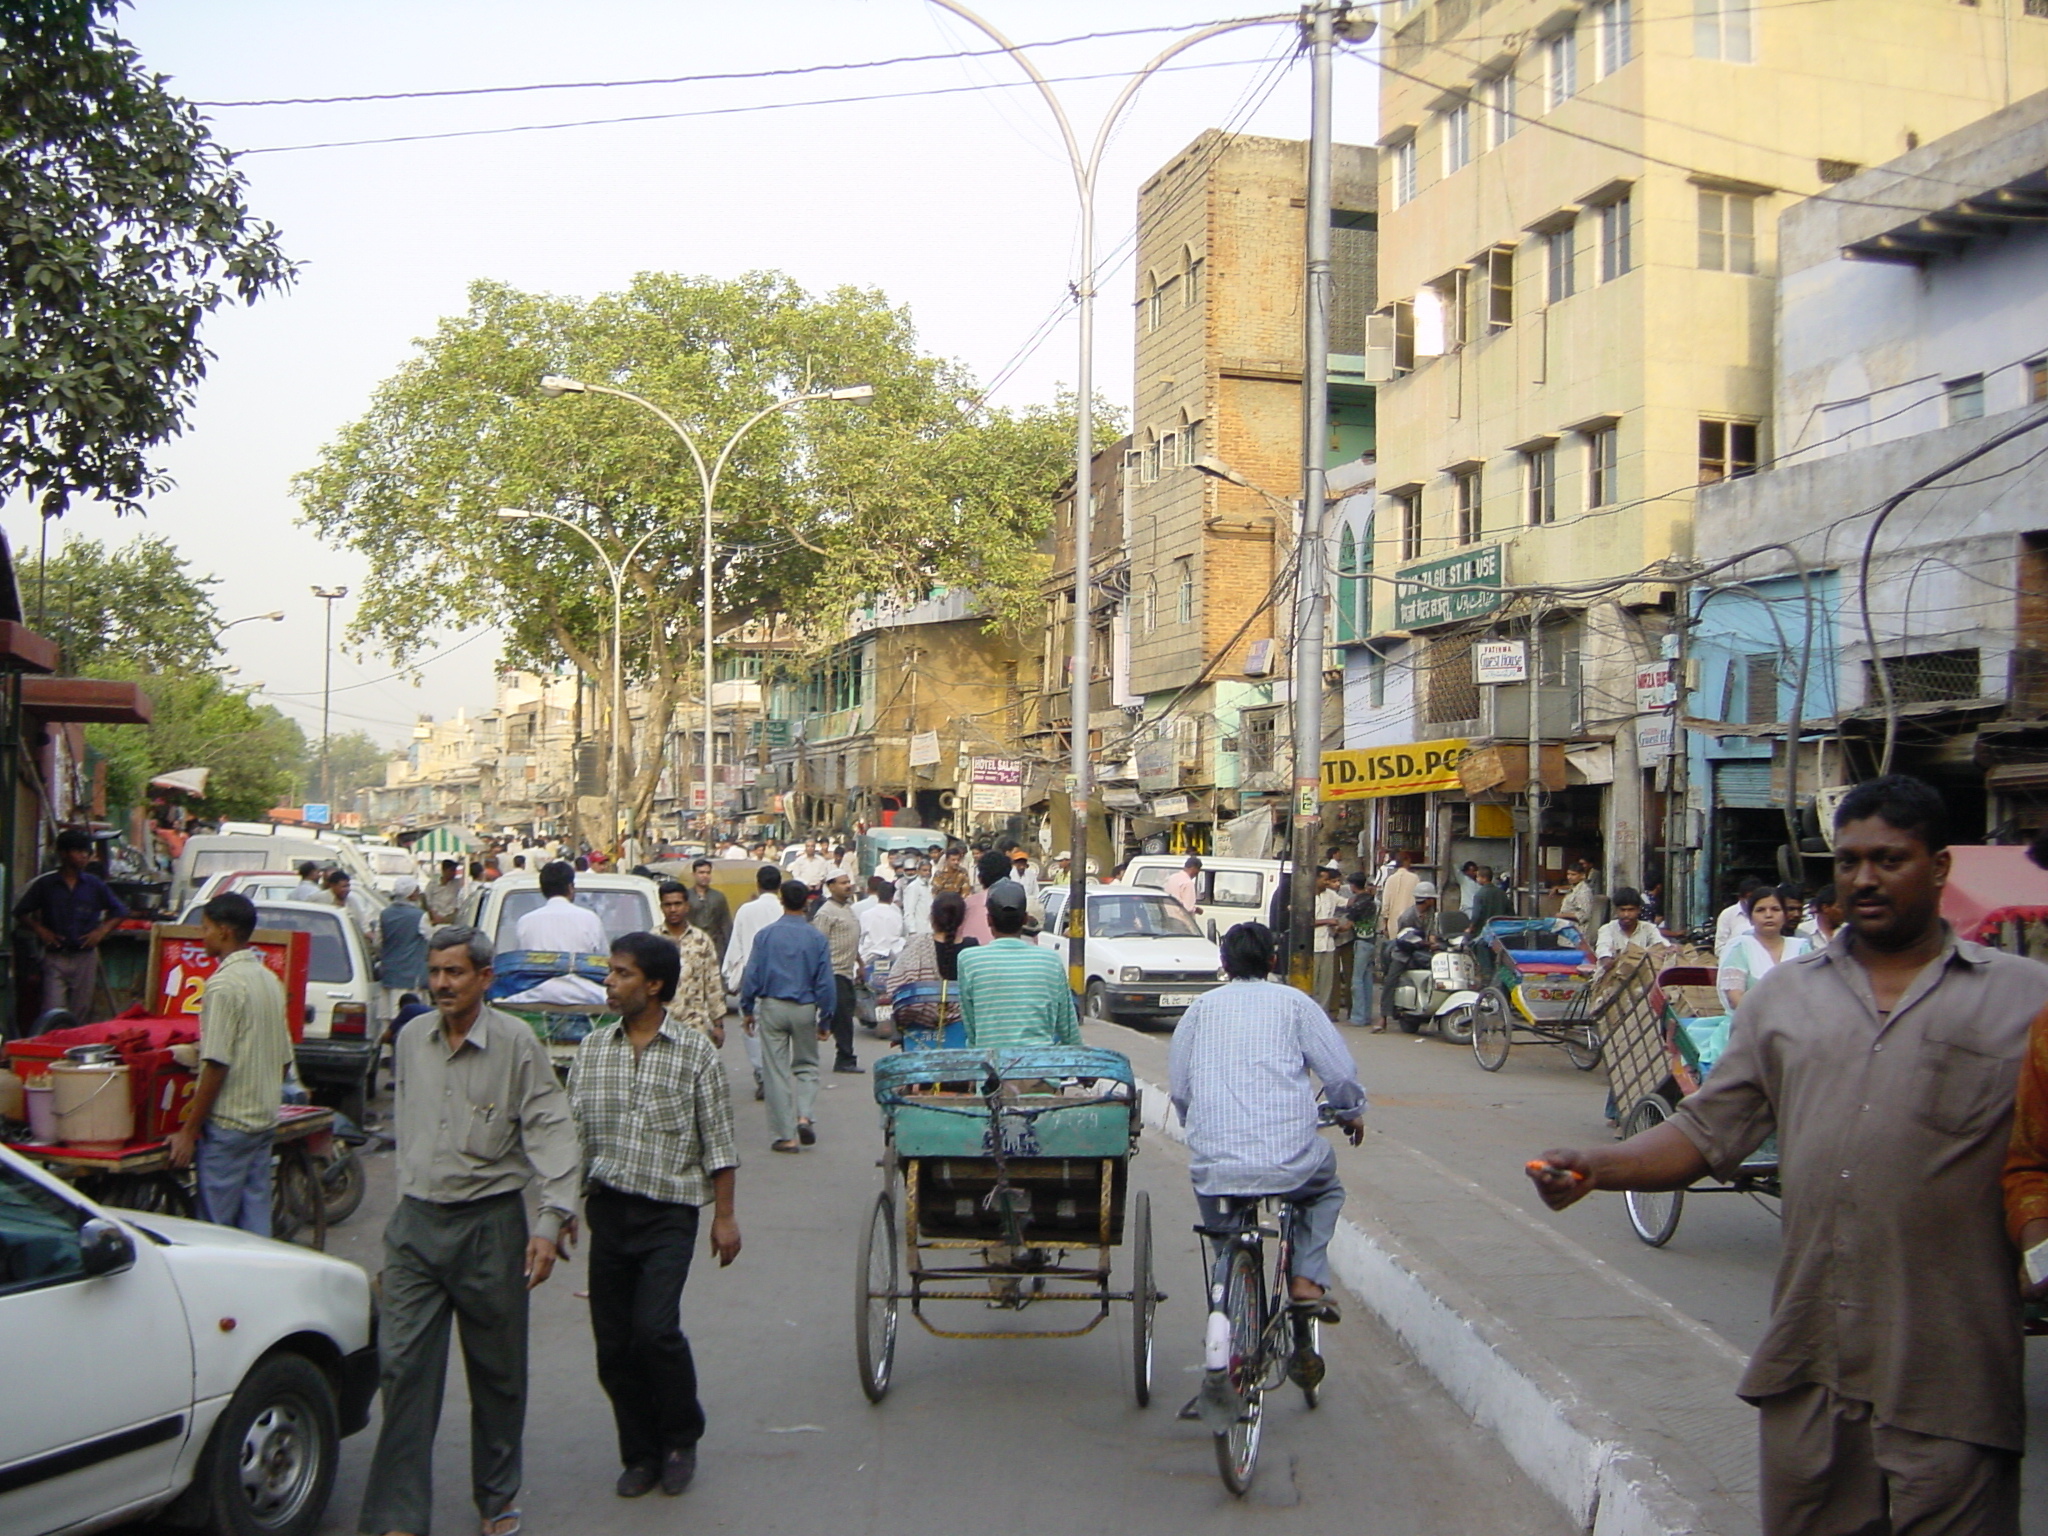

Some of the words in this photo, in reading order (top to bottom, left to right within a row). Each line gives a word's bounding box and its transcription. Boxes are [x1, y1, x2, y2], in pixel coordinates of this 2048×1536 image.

[1434, 564, 1462, 587] GUST
[1463, 555, 1496, 582] HUSE
[1319, 748, 1473, 785] TD.ISD.PC
